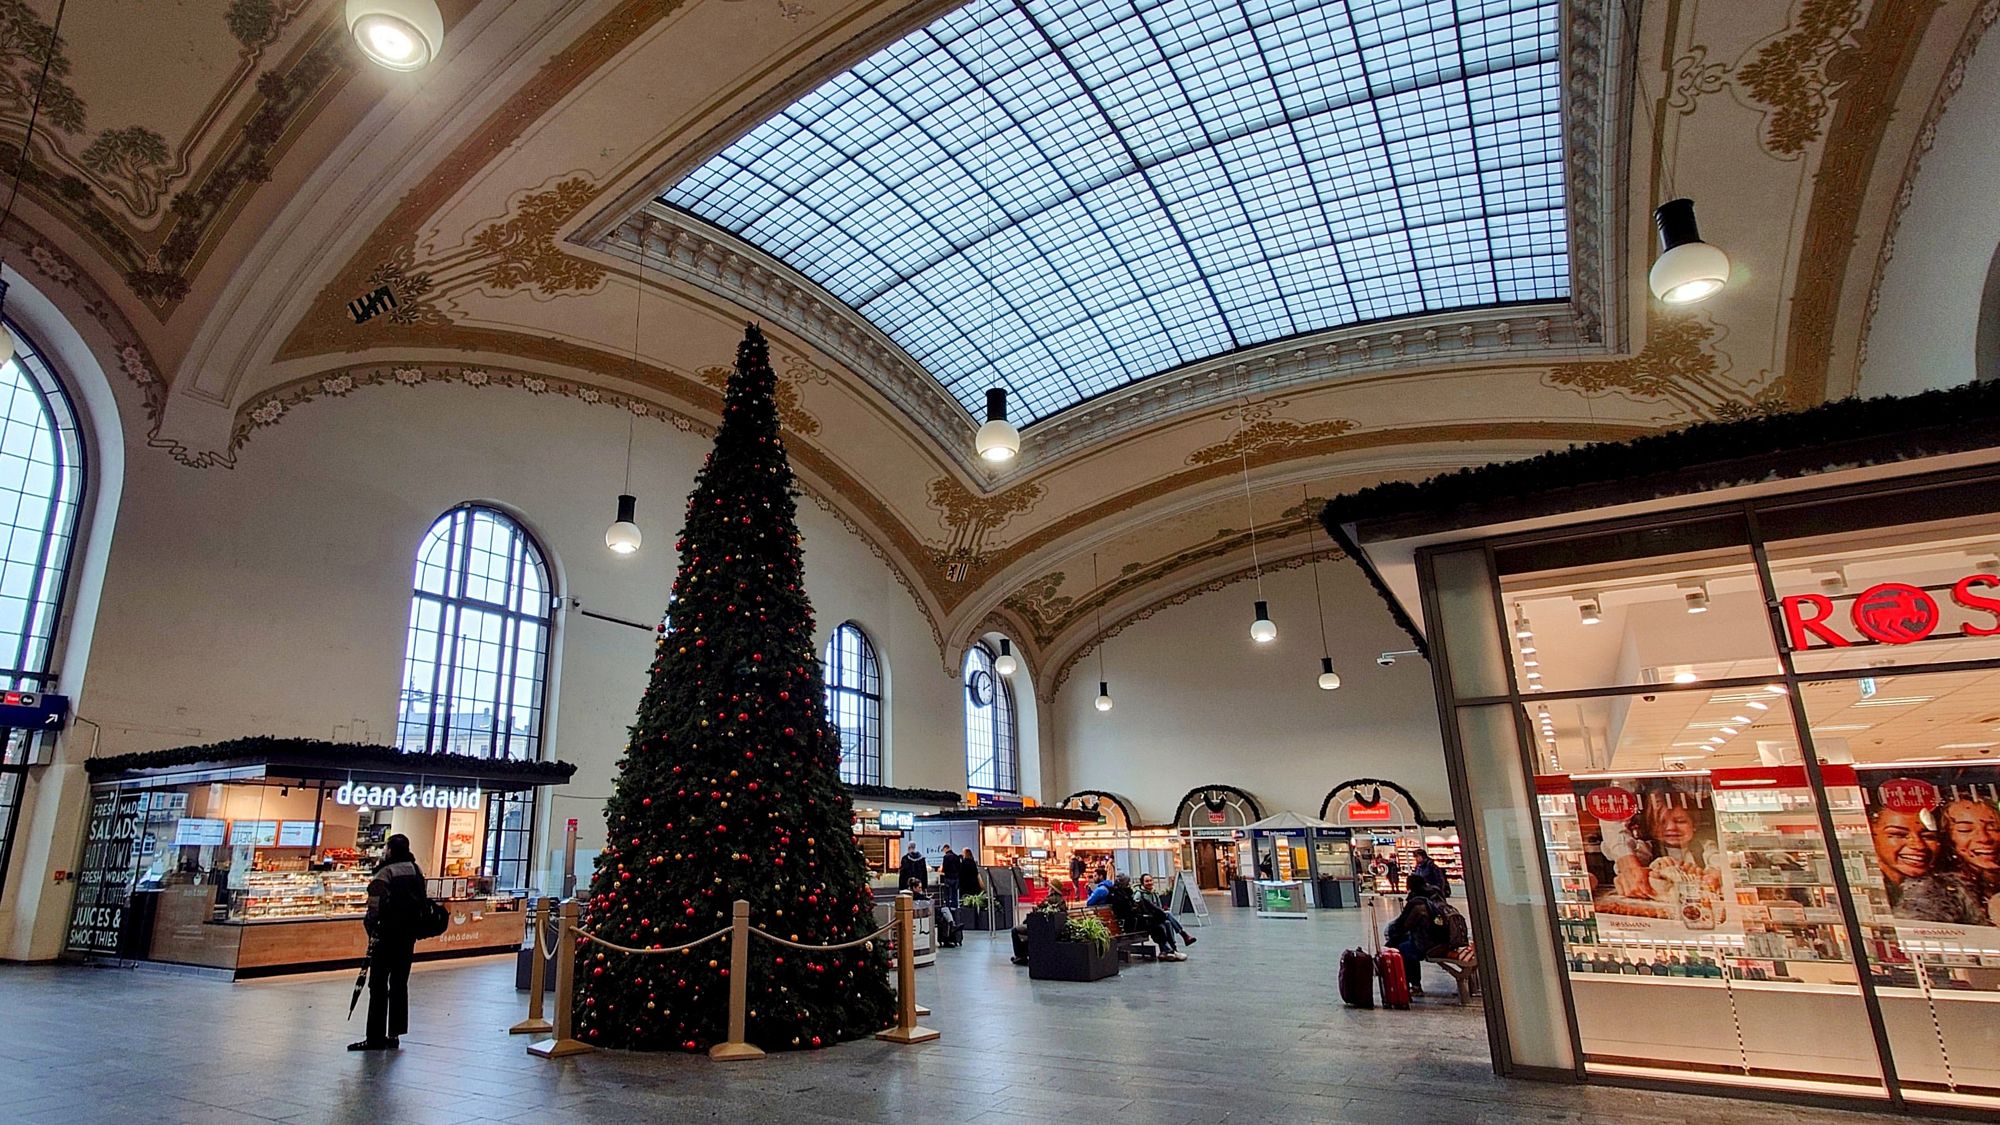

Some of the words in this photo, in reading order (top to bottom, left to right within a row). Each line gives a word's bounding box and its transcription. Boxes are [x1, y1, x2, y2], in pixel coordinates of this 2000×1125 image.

[336, 780, 397, 807] dean
[400, 784, 418, 808] &
[421, 785, 481, 810] david
[89, 817, 139, 840] SALADS
[81, 870, 103, 883] FRESH
[105, 871, 129, 884] WRAPS
[72, 907, 111, 928] JUICES
[112, 908, 121, 928] &
